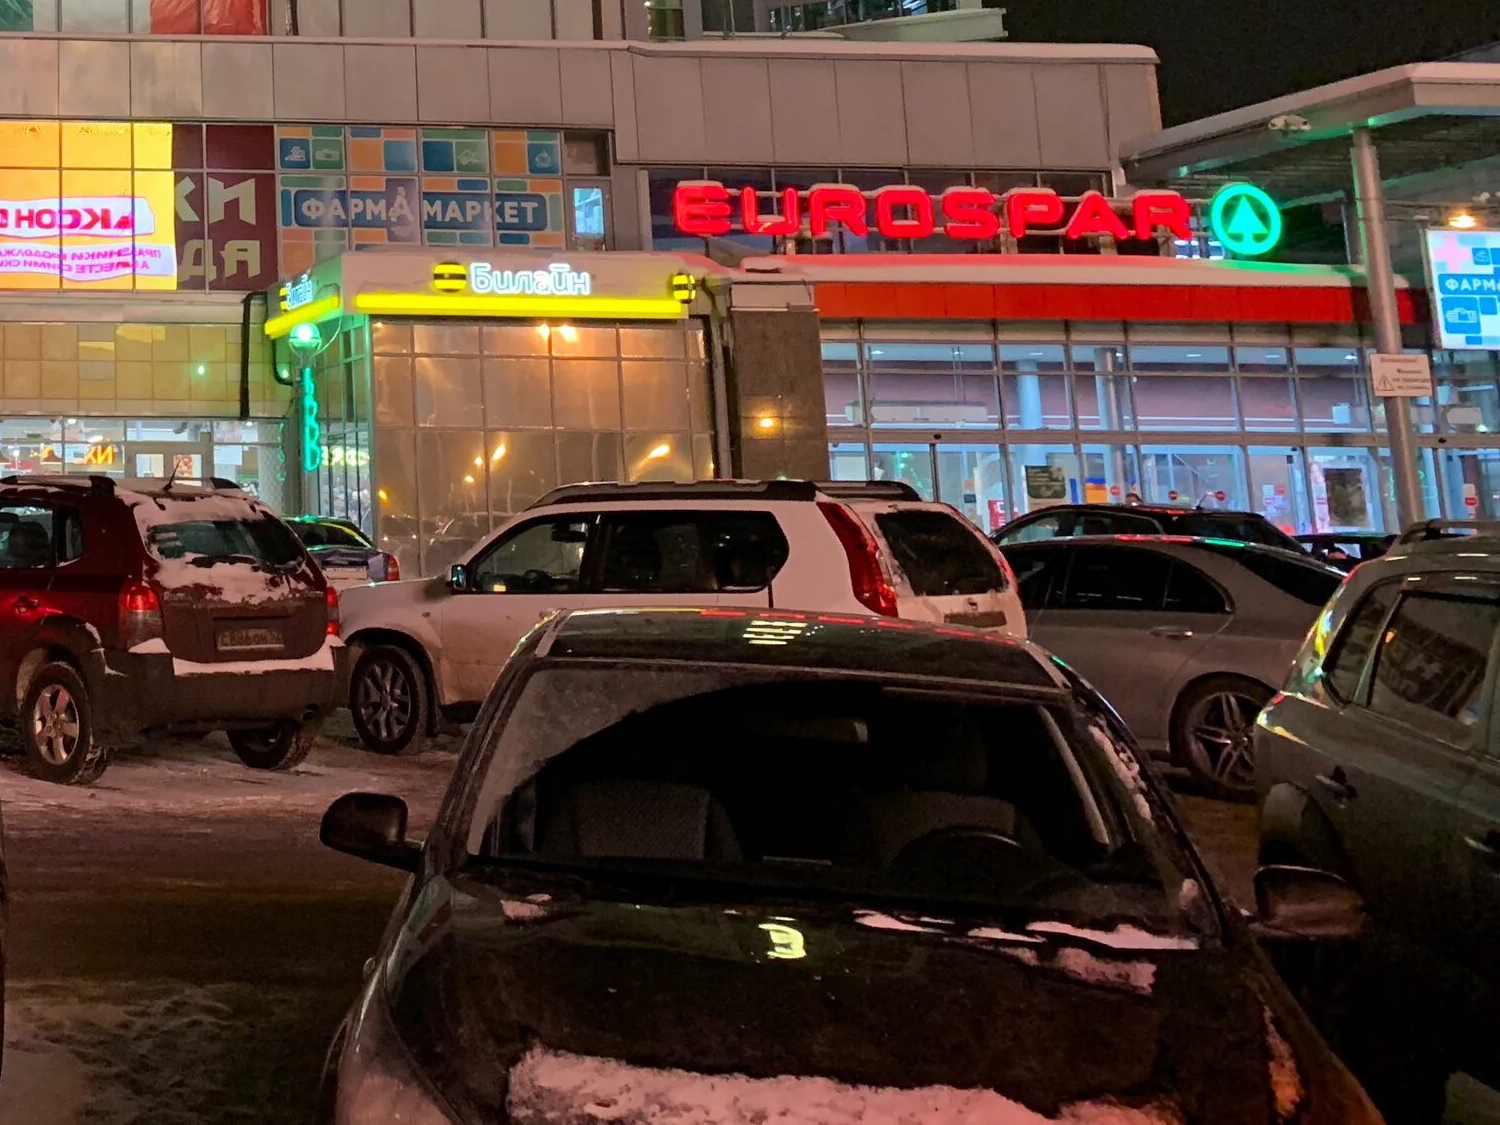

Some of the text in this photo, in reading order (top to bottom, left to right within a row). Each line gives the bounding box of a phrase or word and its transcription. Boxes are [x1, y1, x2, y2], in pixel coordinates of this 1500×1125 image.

[672, 181, 1193, 241] EUROSPAR
[470, 261, 592, 296] билайн
[1445, 278, 1500, 292] ФАРМ
